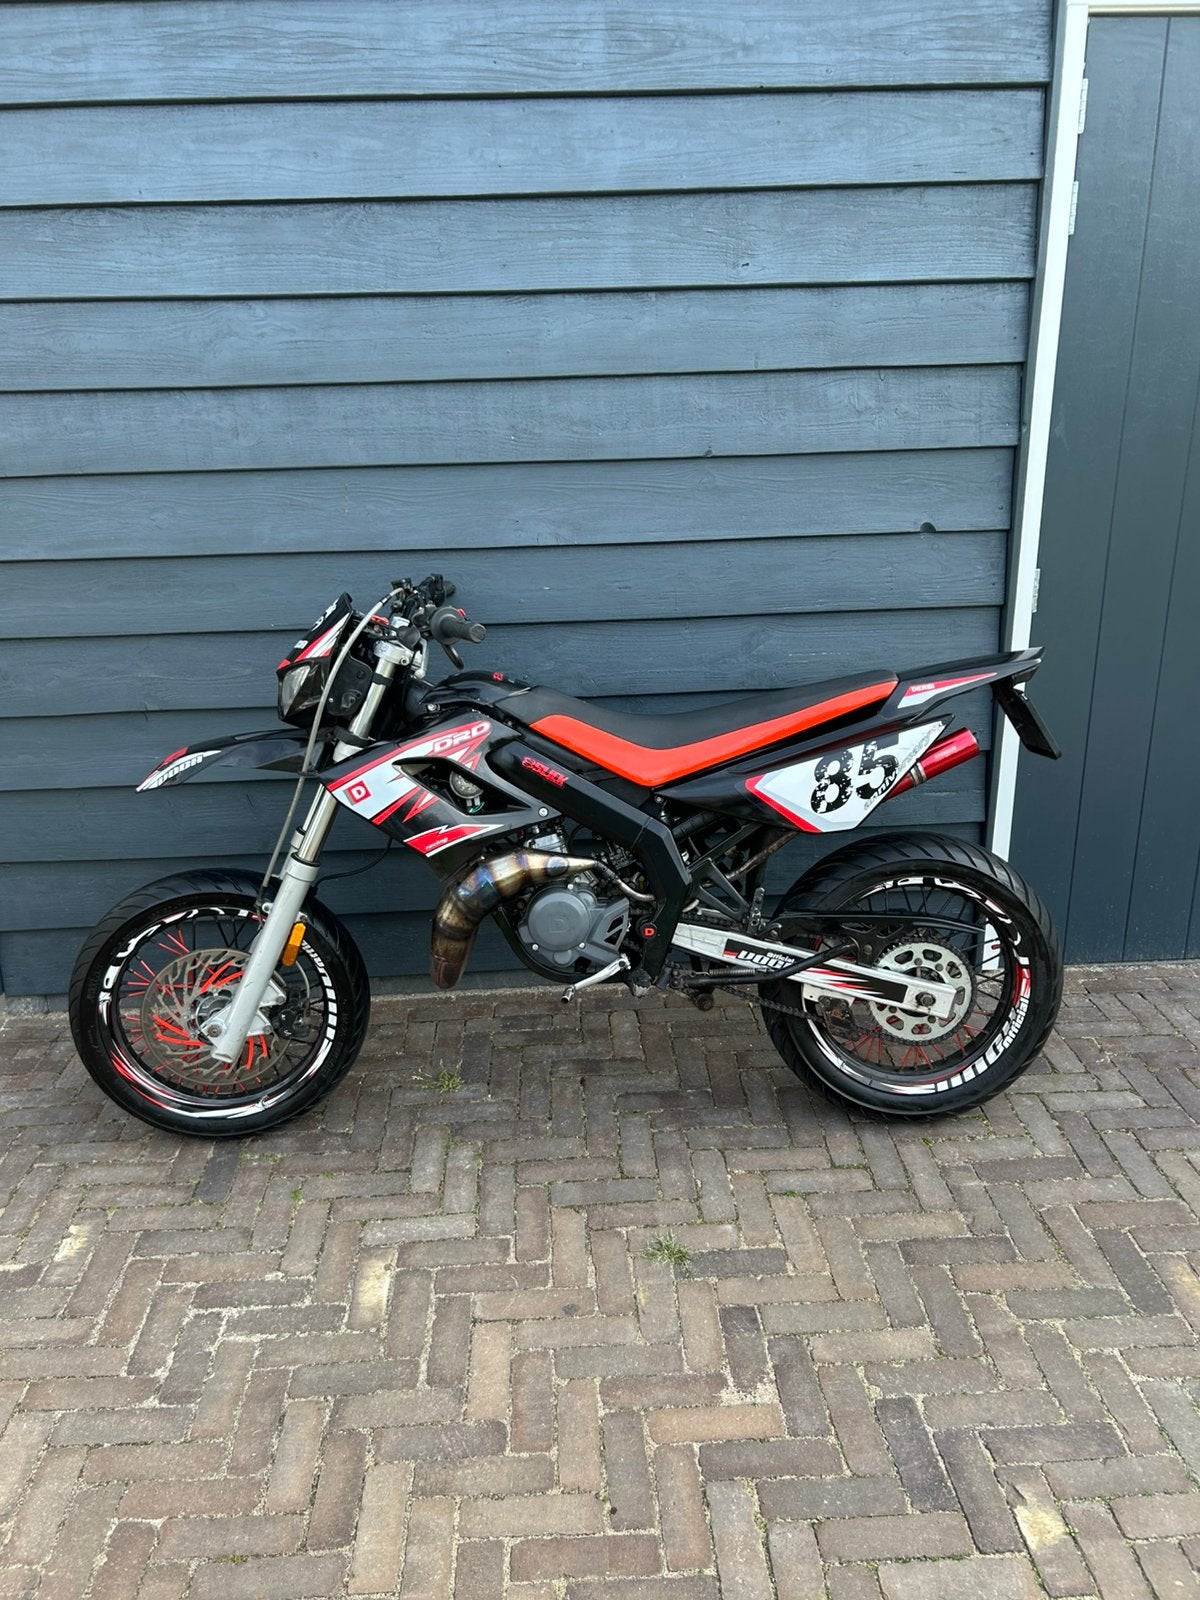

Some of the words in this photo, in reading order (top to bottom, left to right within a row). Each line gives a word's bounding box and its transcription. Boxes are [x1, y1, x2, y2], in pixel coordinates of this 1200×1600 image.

[432, 721, 491, 752] DRD
[810, 733, 899, 814] 85
[644, 928, 655, 937] D
